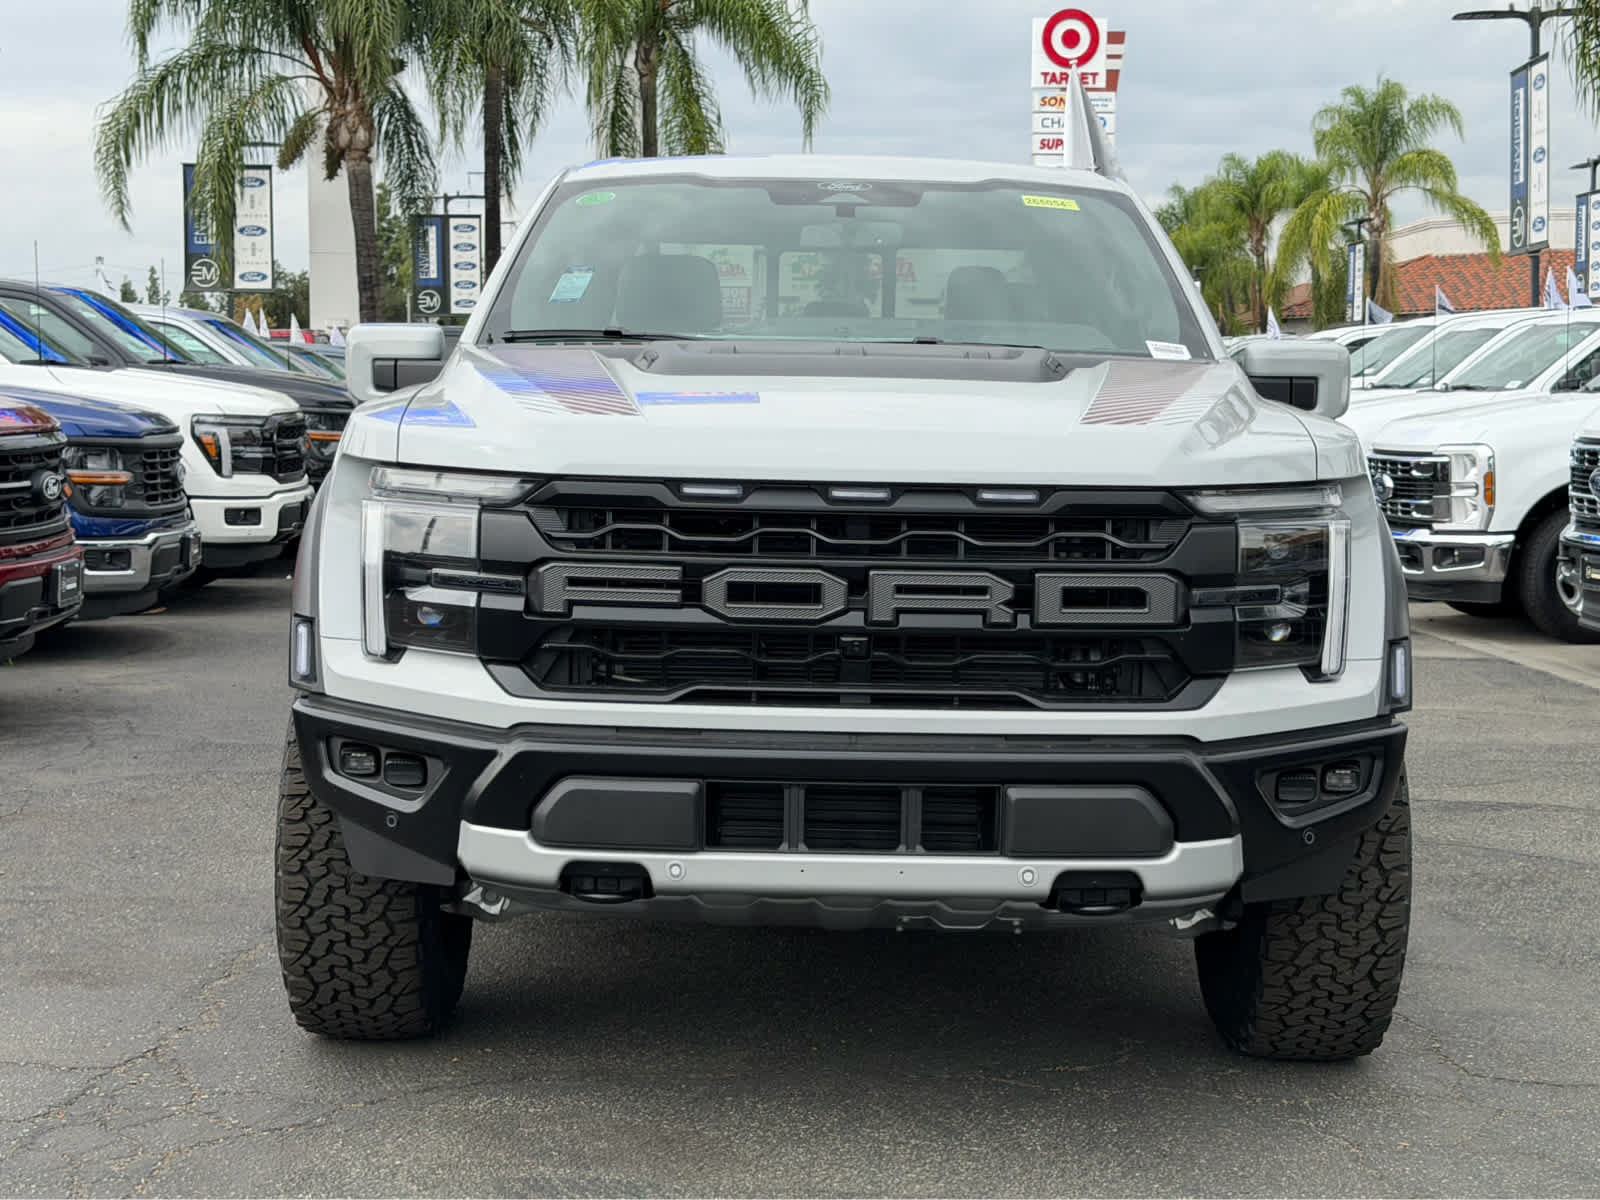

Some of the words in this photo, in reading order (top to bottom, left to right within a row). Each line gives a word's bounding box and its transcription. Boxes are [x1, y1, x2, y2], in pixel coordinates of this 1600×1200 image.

[1040, 72, 1098, 85] TARET
[1039, 96, 1066, 107] SON
[1039, 138, 1064, 150] SUP
[532, 562, 1183, 625] FORD
